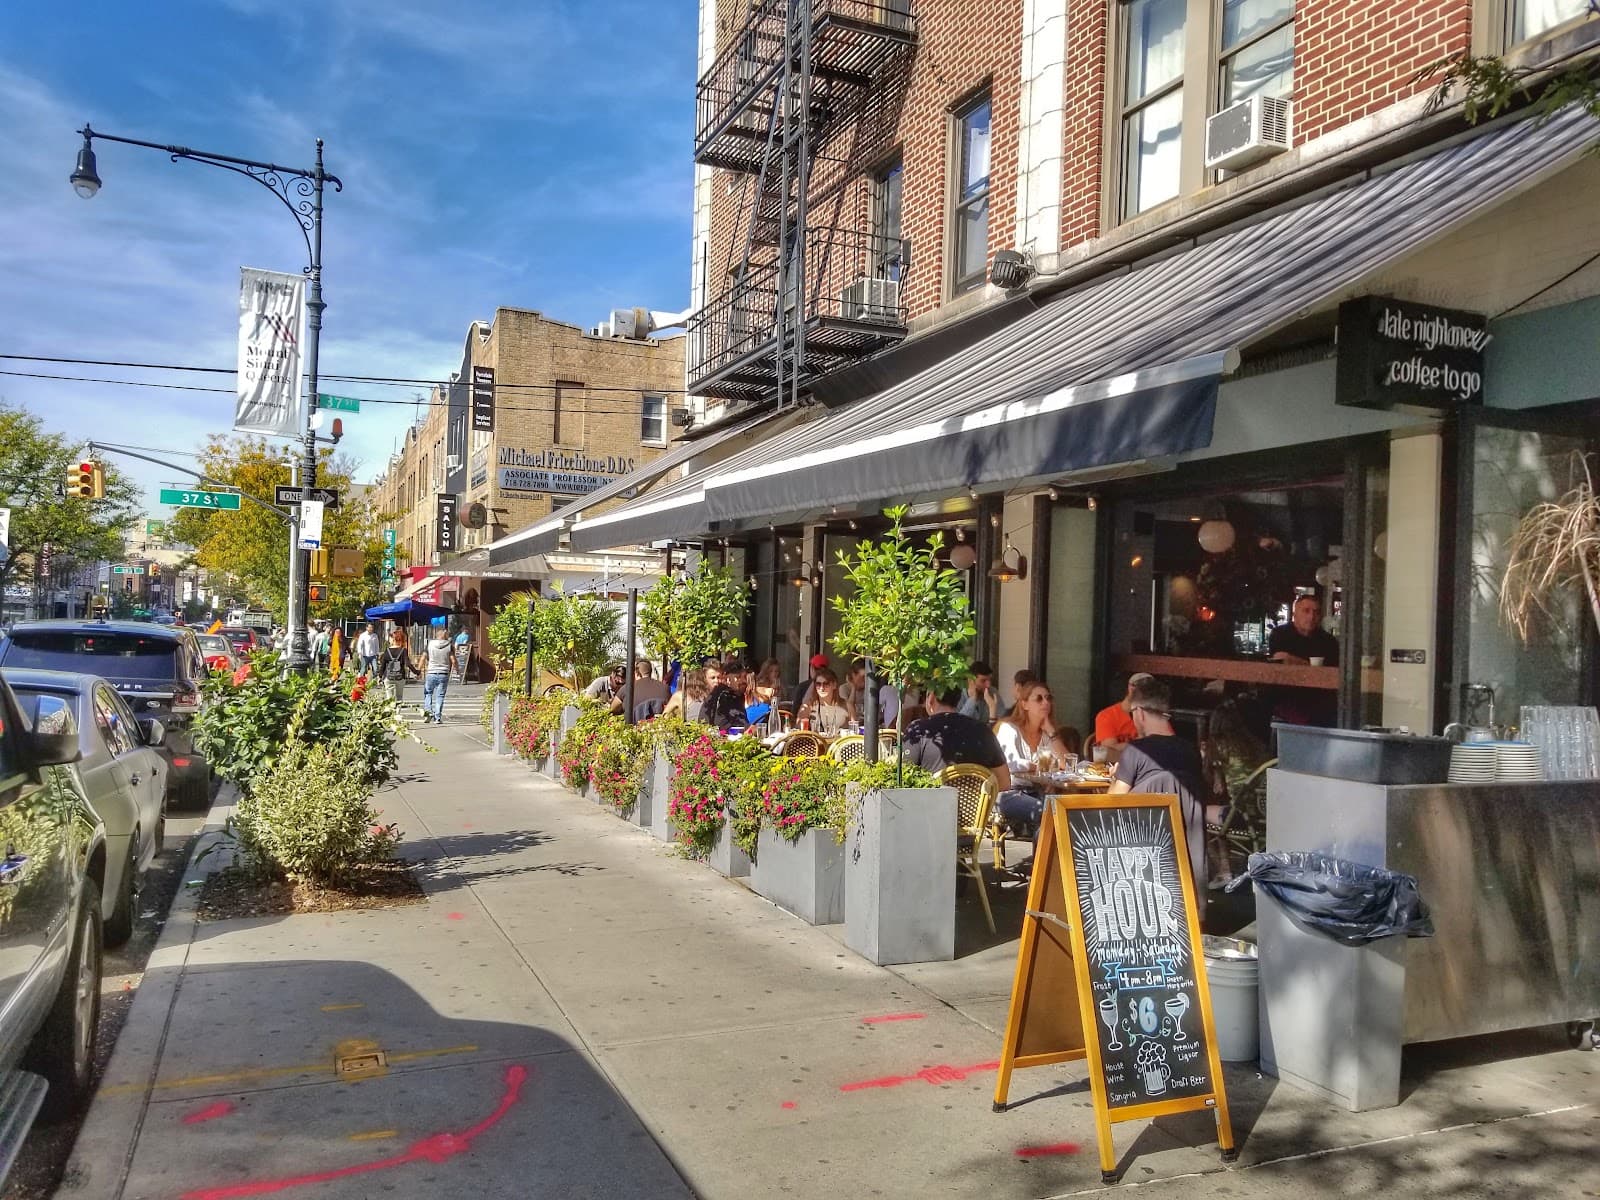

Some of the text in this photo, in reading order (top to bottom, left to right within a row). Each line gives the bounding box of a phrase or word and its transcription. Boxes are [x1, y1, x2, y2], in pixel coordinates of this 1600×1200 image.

[1384, 307, 1411, 340] late
[1413, 313, 1448, 350] night
[246, 346, 287, 359] Mount
[246, 358, 279, 370] Sinai
[246, 371, 291, 384] Queens
[1391, 356, 1481, 399] coffee to go
[327, 398, 343, 409] 37
[499, 447, 545, 468] Michael
[505, 470, 550, 480] ASSOCIATE
[552, 474, 597, 484] PROFESSOR
[182, 493, 219, 505] 37 St
[284, 492, 302, 501] ONE
[442, 506, 450, 547] SALON
[1085, 846, 1163, 888] HAPPY
[1090, 879, 1178, 942] HOUR
[1166, 980, 1194, 992] Margarita
[1172, 1040, 1200, 1052] Premium
[1178, 1051, 1199, 1062] Liquor
[1105, 1062, 1125, 1071] House
[1106, 1075, 1125, 1084] Wine
[1171, 1075, 1206, 1088] Draft Beer
[1110, 1090, 1137, 1104] Sangria
